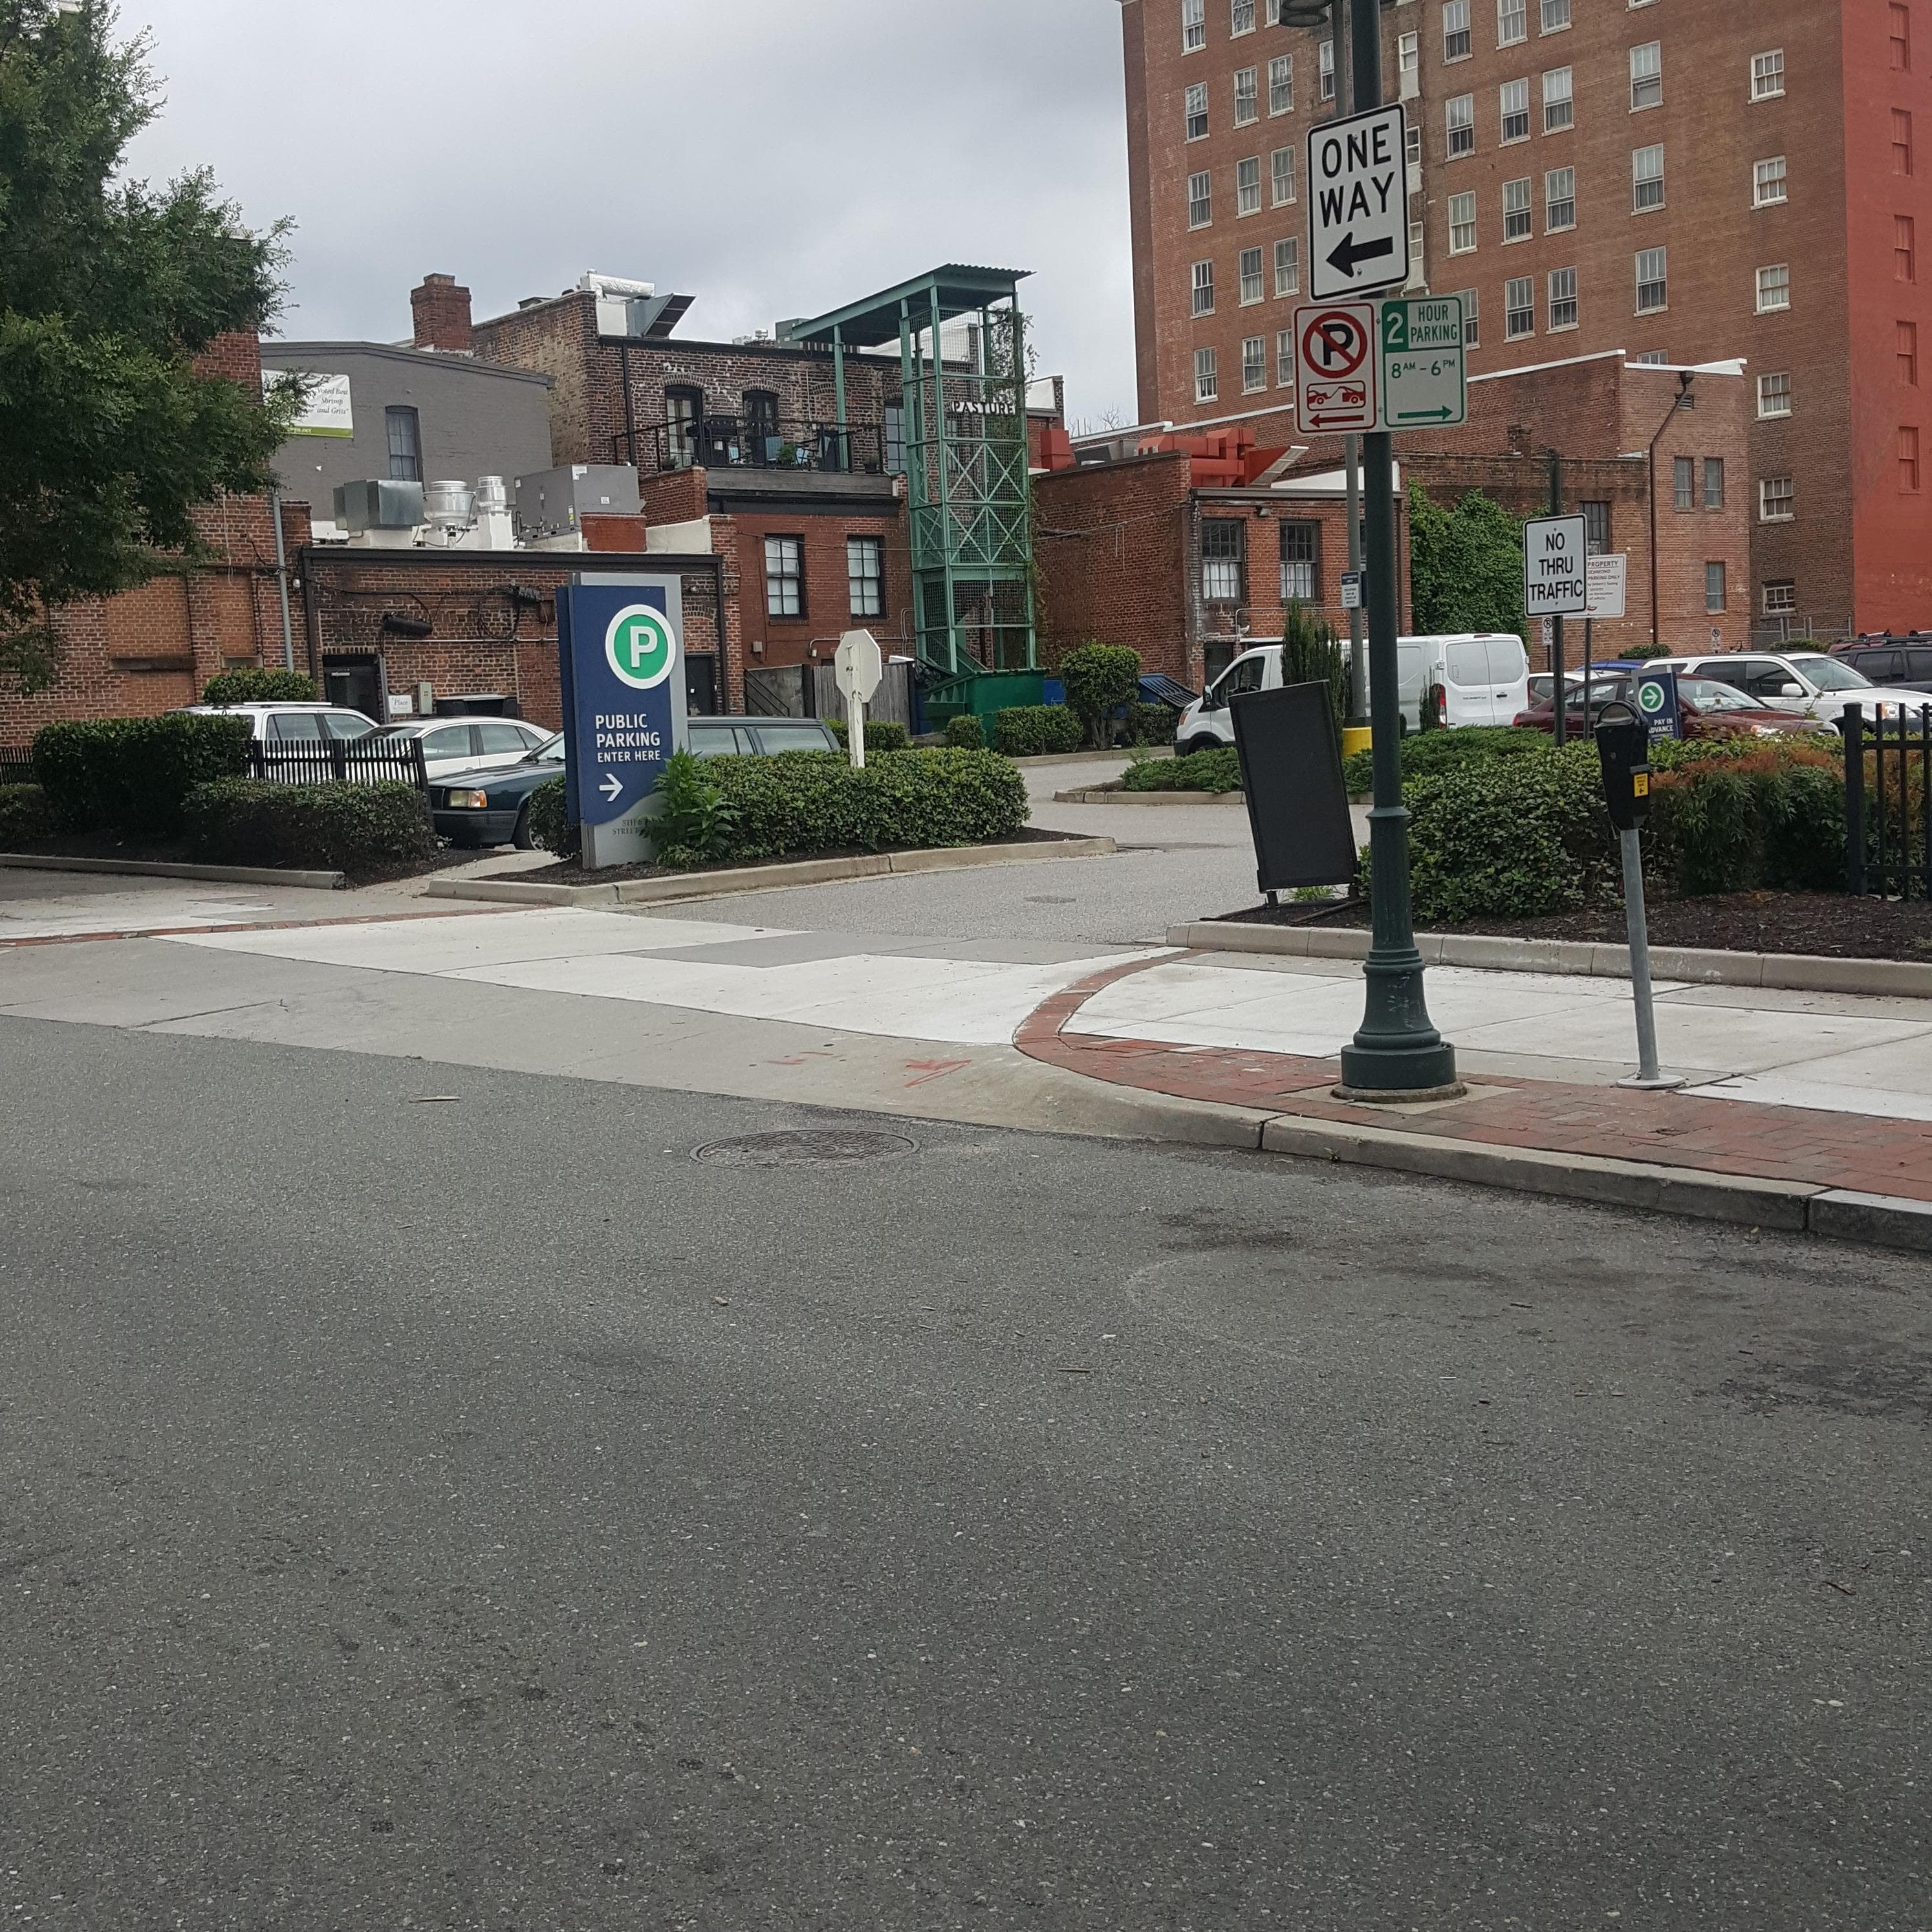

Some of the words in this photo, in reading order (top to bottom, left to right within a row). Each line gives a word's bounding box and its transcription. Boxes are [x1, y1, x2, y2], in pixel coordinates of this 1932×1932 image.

[1321, 123, 1391, 179] ONE
[1319, 171, 1395, 228] WAY
[1418, 305, 1448, 322] HOUR
[1387, 312, 1404, 344] 2
[1411, 324, 1457, 343] PARKING
[953, 401, 1015, 415] PASTURE
[1546, 532, 1565, 552] NO
[1539, 556, 1574, 576] THRU
[1530, 580, 1583, 601] TRAFFIC
[630, 625, 658, 668] P
[595, 713, 647, 730] PUBLIC
[596, 732, 660, 748] PARKING
[598, 752, 631, 763] ENTER
[635, 750, 661, 762] HERE
